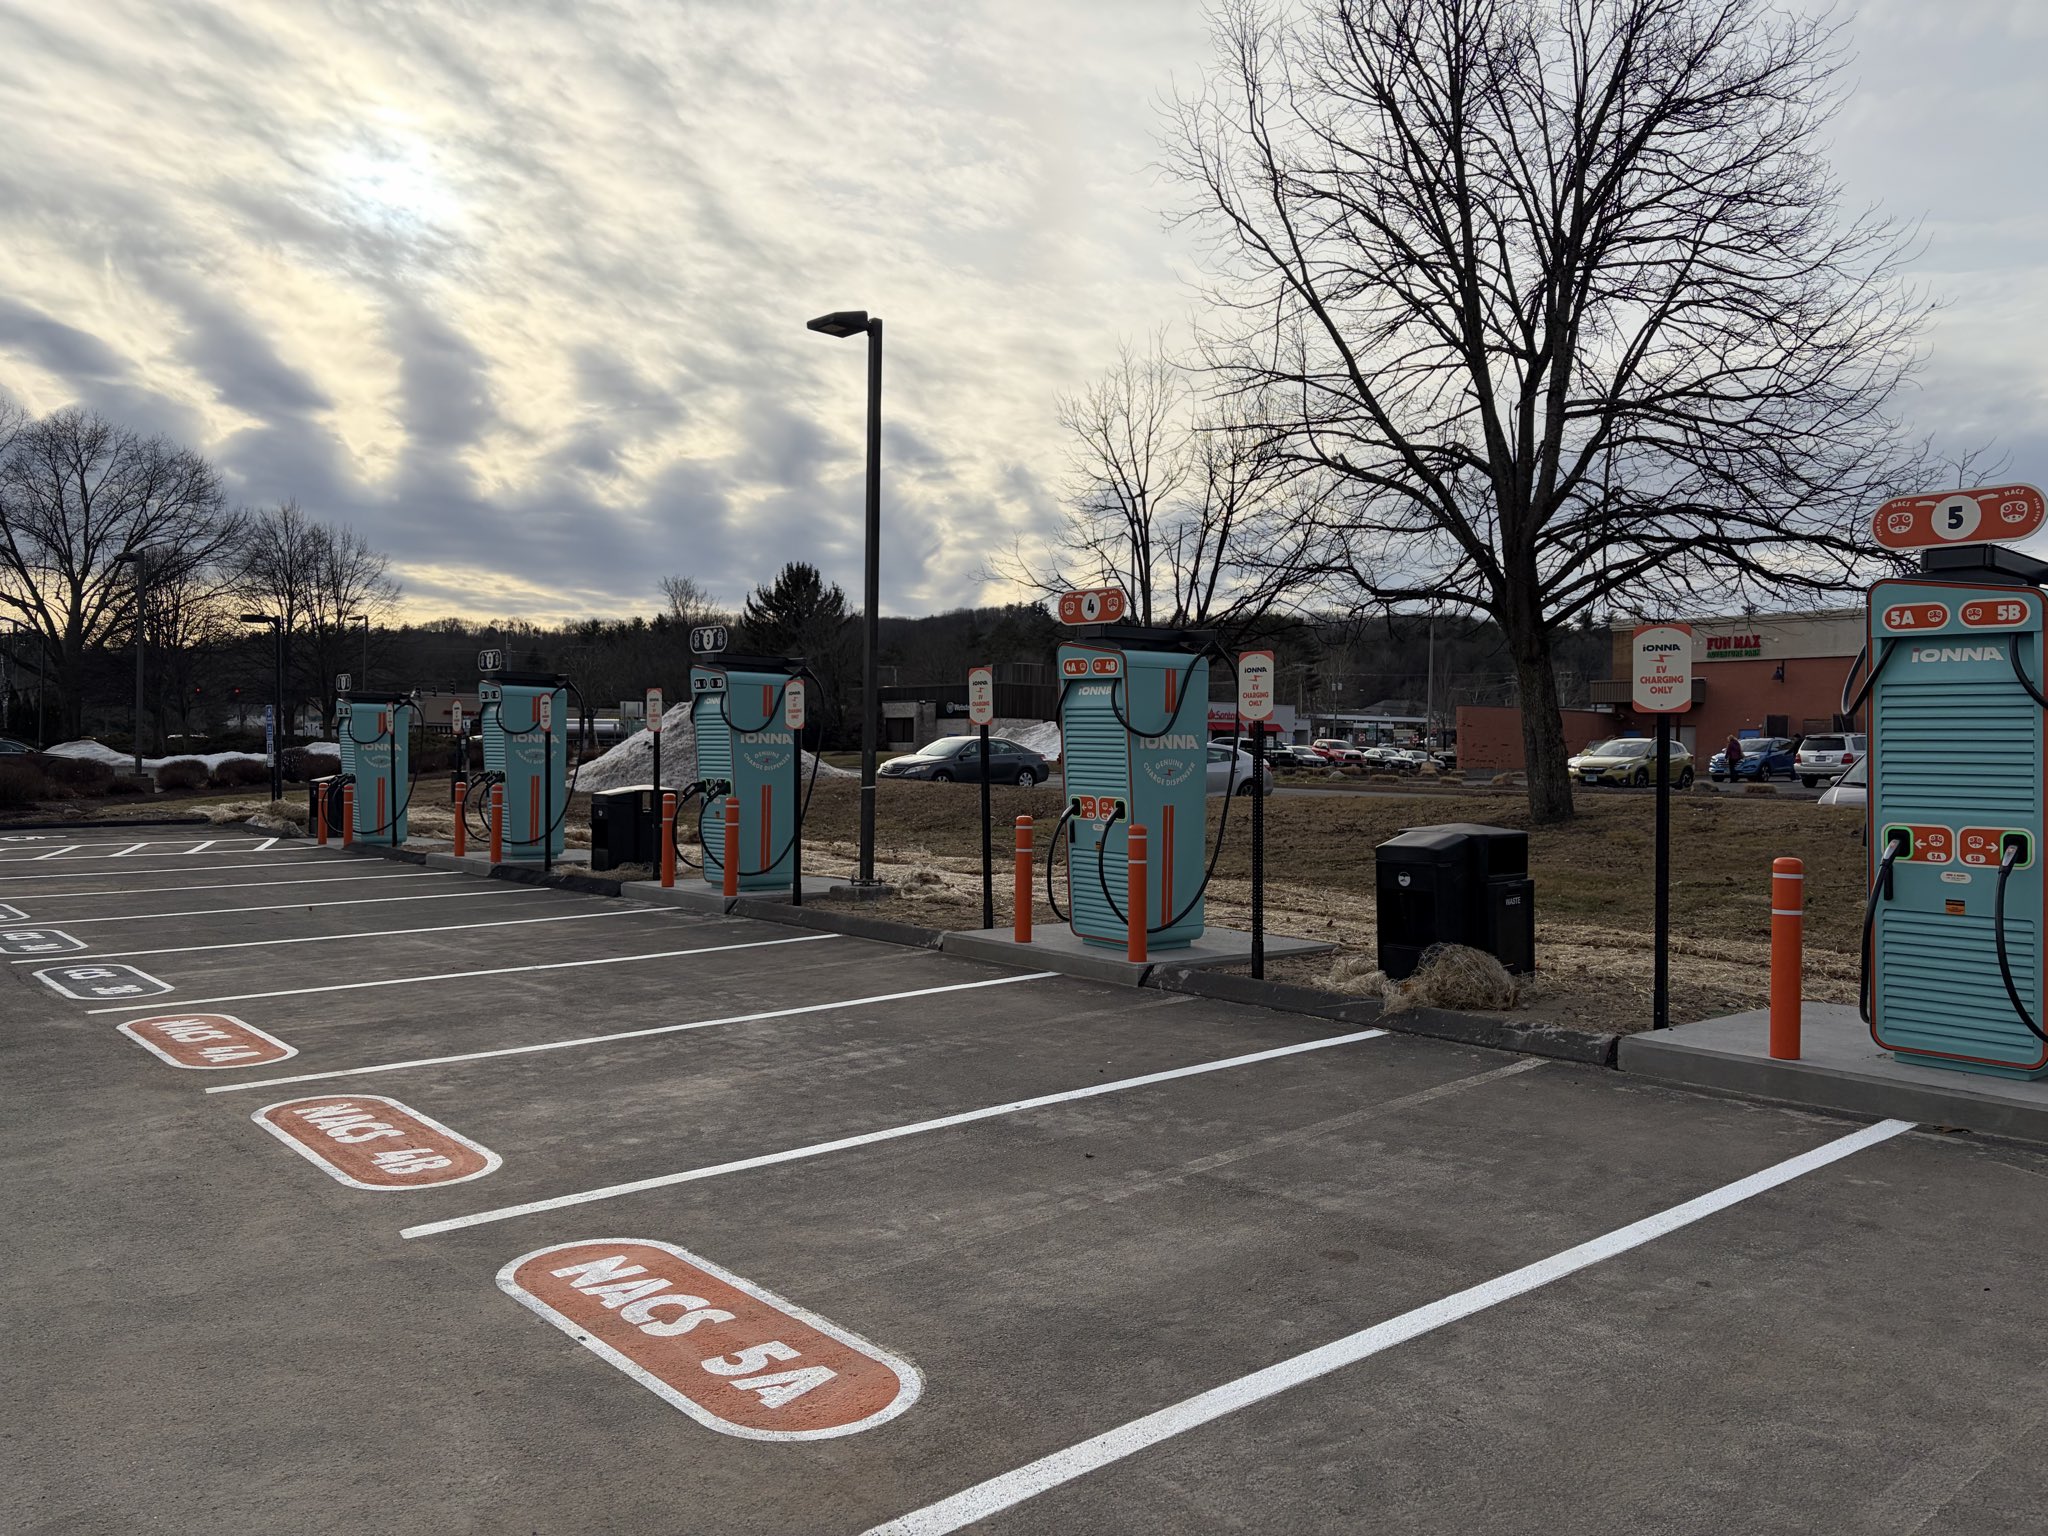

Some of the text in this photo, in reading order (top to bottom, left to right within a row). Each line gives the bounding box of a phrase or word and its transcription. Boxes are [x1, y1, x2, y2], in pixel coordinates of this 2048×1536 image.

[2004, 488, 2024, 496] NACS
[1948, 505, 1964, 530] 5
[1087, 599, 1095, 613] 4
[1997, 604, 2021, 620] 5B
[1890, 610, 1915, 626] 5A
[706, 634, 711, 645] 3
[1707, 635, 1761, 650] FUN MAX
[1066, 662, 1076, 672] 4A
[1105, 661, 1116, 671] 4B
[1656, 665, 1667, 673] EV
[1640, 675, 1684, 684] CHARGING
[1650, 686, 1673, 694] ONLY
[1155, 758, 1184, 770] GENUINE
[1143, 762, 1196, 786] CHARGE DISPENSER
[1505, 896, 1521, 906] WASTE
[63, 968, 117, 980] CCS
[151, 1018, 232, 1043] NACS
[197, 1045, 261, 1063] 4A
[292, 1102, 406, 1144] NACS
[370, 1147, 453, 1175] 4B
[550, 1254, 736, 1337] NACS
[701, 1340, 838, 1409] 5A
